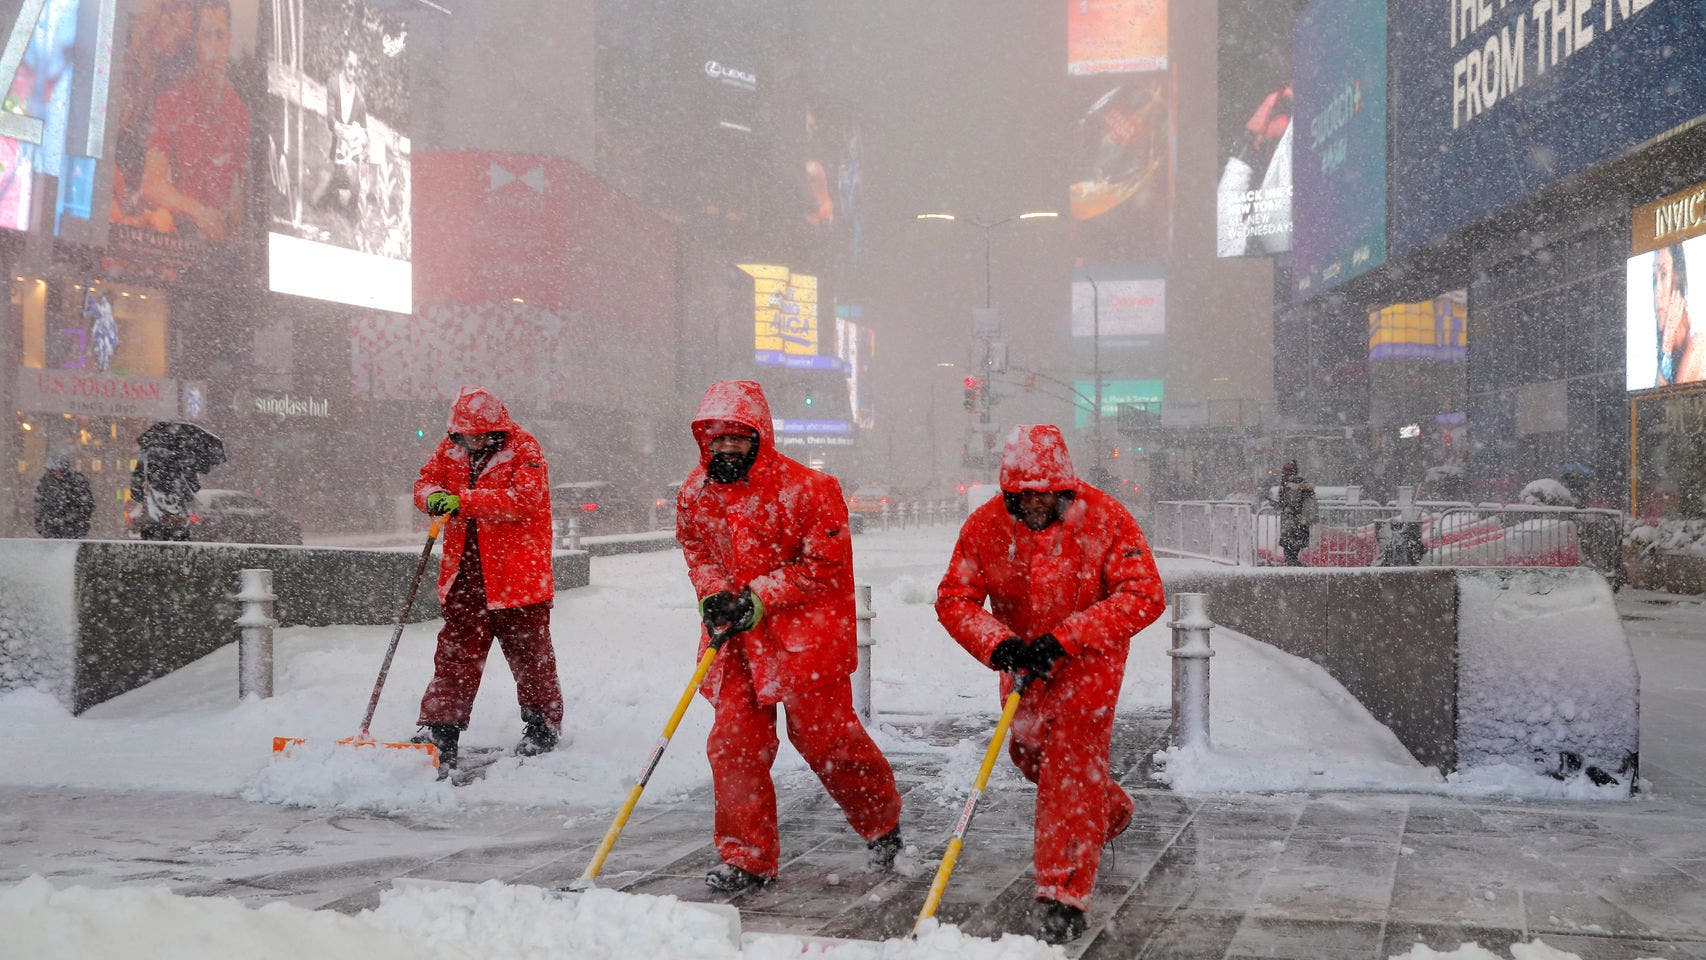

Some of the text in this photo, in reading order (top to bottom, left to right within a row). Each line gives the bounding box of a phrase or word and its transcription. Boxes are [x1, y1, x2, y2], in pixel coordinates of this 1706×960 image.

[722, 66, 756, 83] LEXUS
[1453, 13, 1525, 130] FROM
[1532, 0, 1594, 76] THE
[1655, 189, 1706, 240] INVIC
[71, 374, 117, 399] POLO
[255, 393, 308, 421] sunglass
